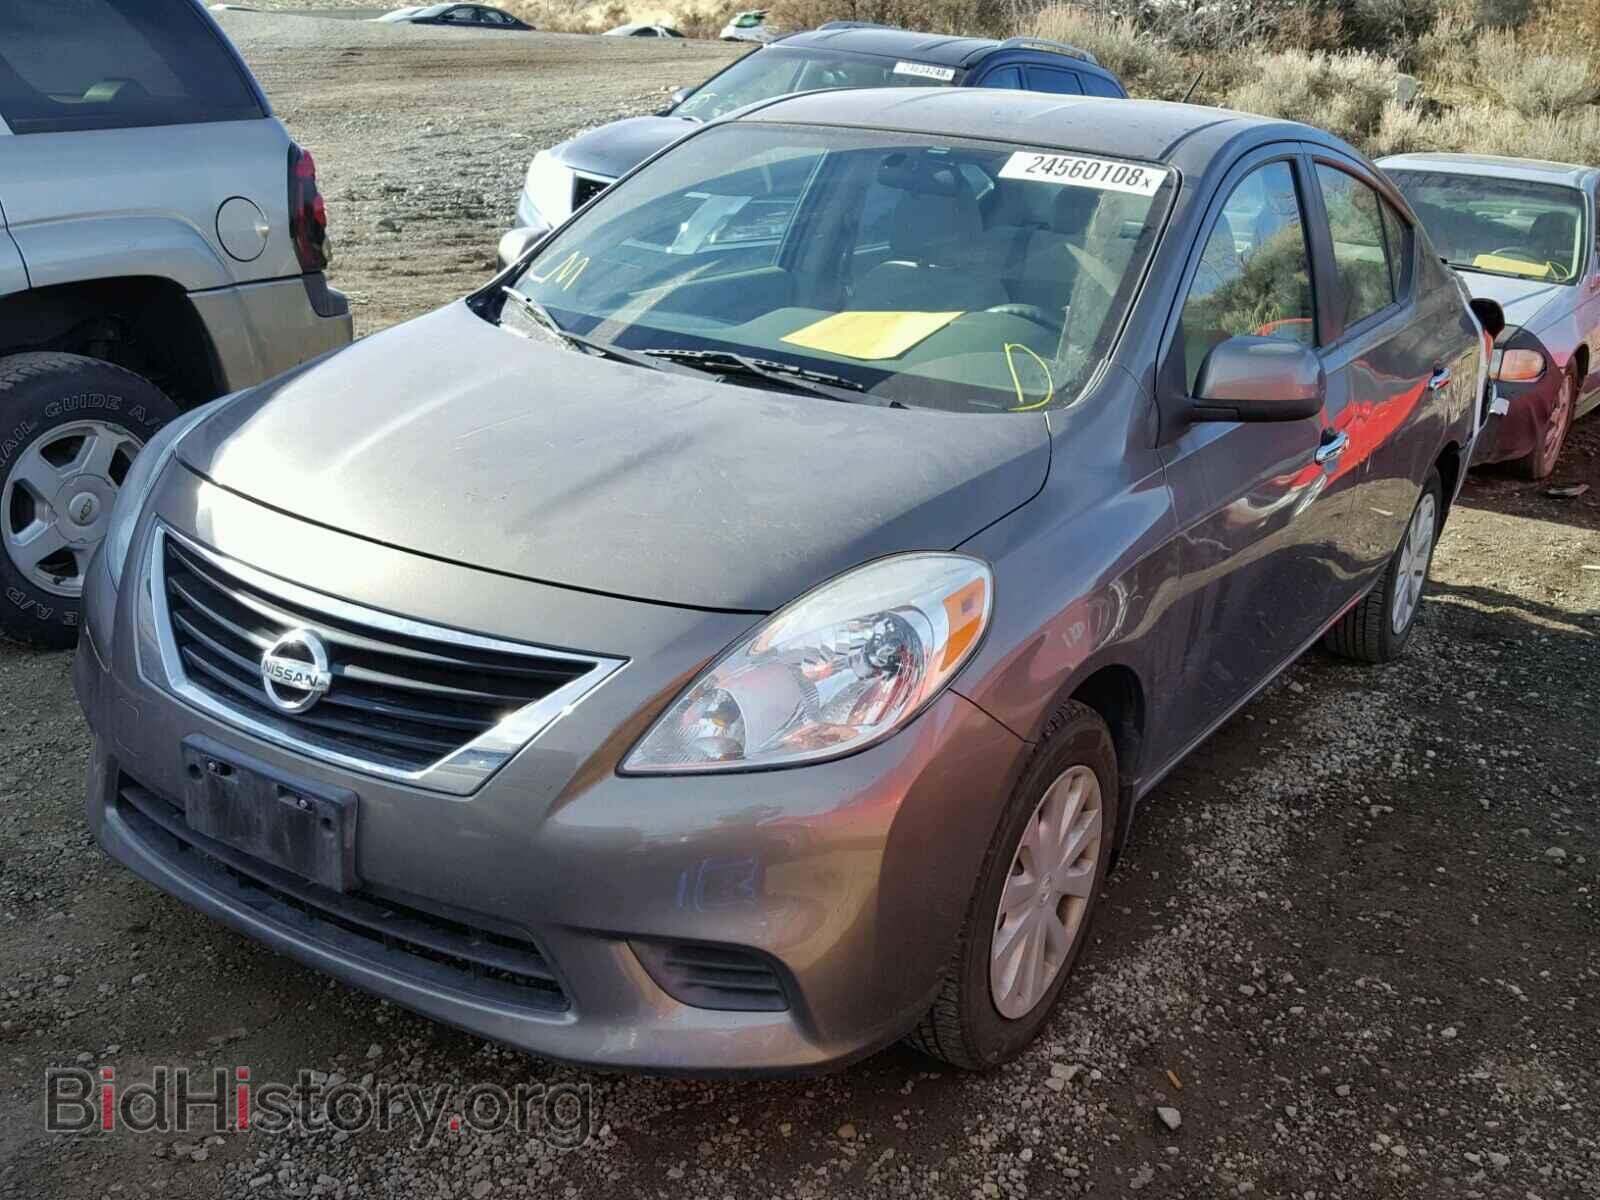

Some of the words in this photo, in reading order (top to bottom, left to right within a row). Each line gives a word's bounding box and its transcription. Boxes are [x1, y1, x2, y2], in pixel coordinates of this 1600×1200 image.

[0, 420, 38, 468] AIL
[44, 393, 122, 417] GUIDE
[263, 659, 319, 687] NISSAN
